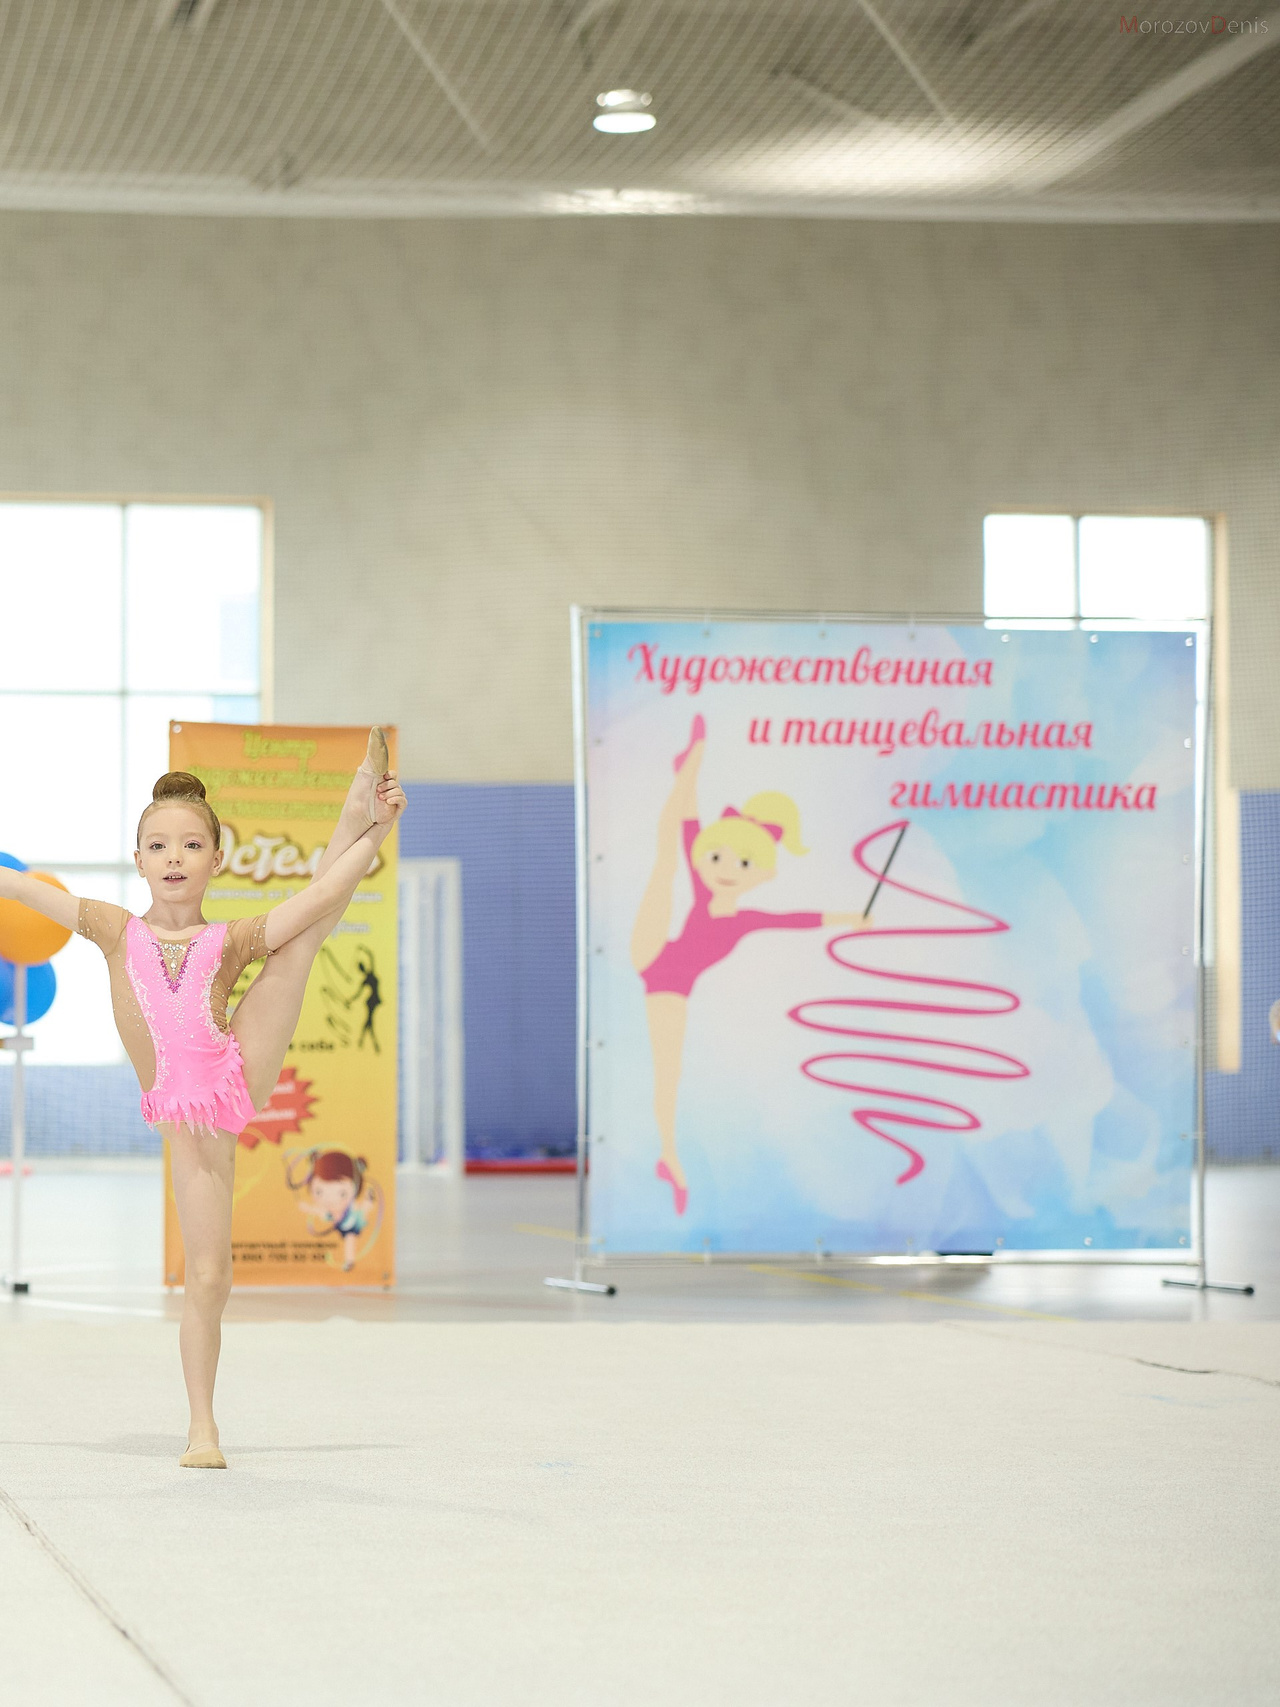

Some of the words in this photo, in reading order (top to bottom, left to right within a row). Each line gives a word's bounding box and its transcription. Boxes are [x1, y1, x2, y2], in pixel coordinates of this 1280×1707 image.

[627, 642, 994, 695] Художественная
[243, 731, 317, 772] Центр
[747, 716, 772, 747] и
[781, 707, 1094, 756] танцевальная
[889, 780, 1158, 812] гимнастика
